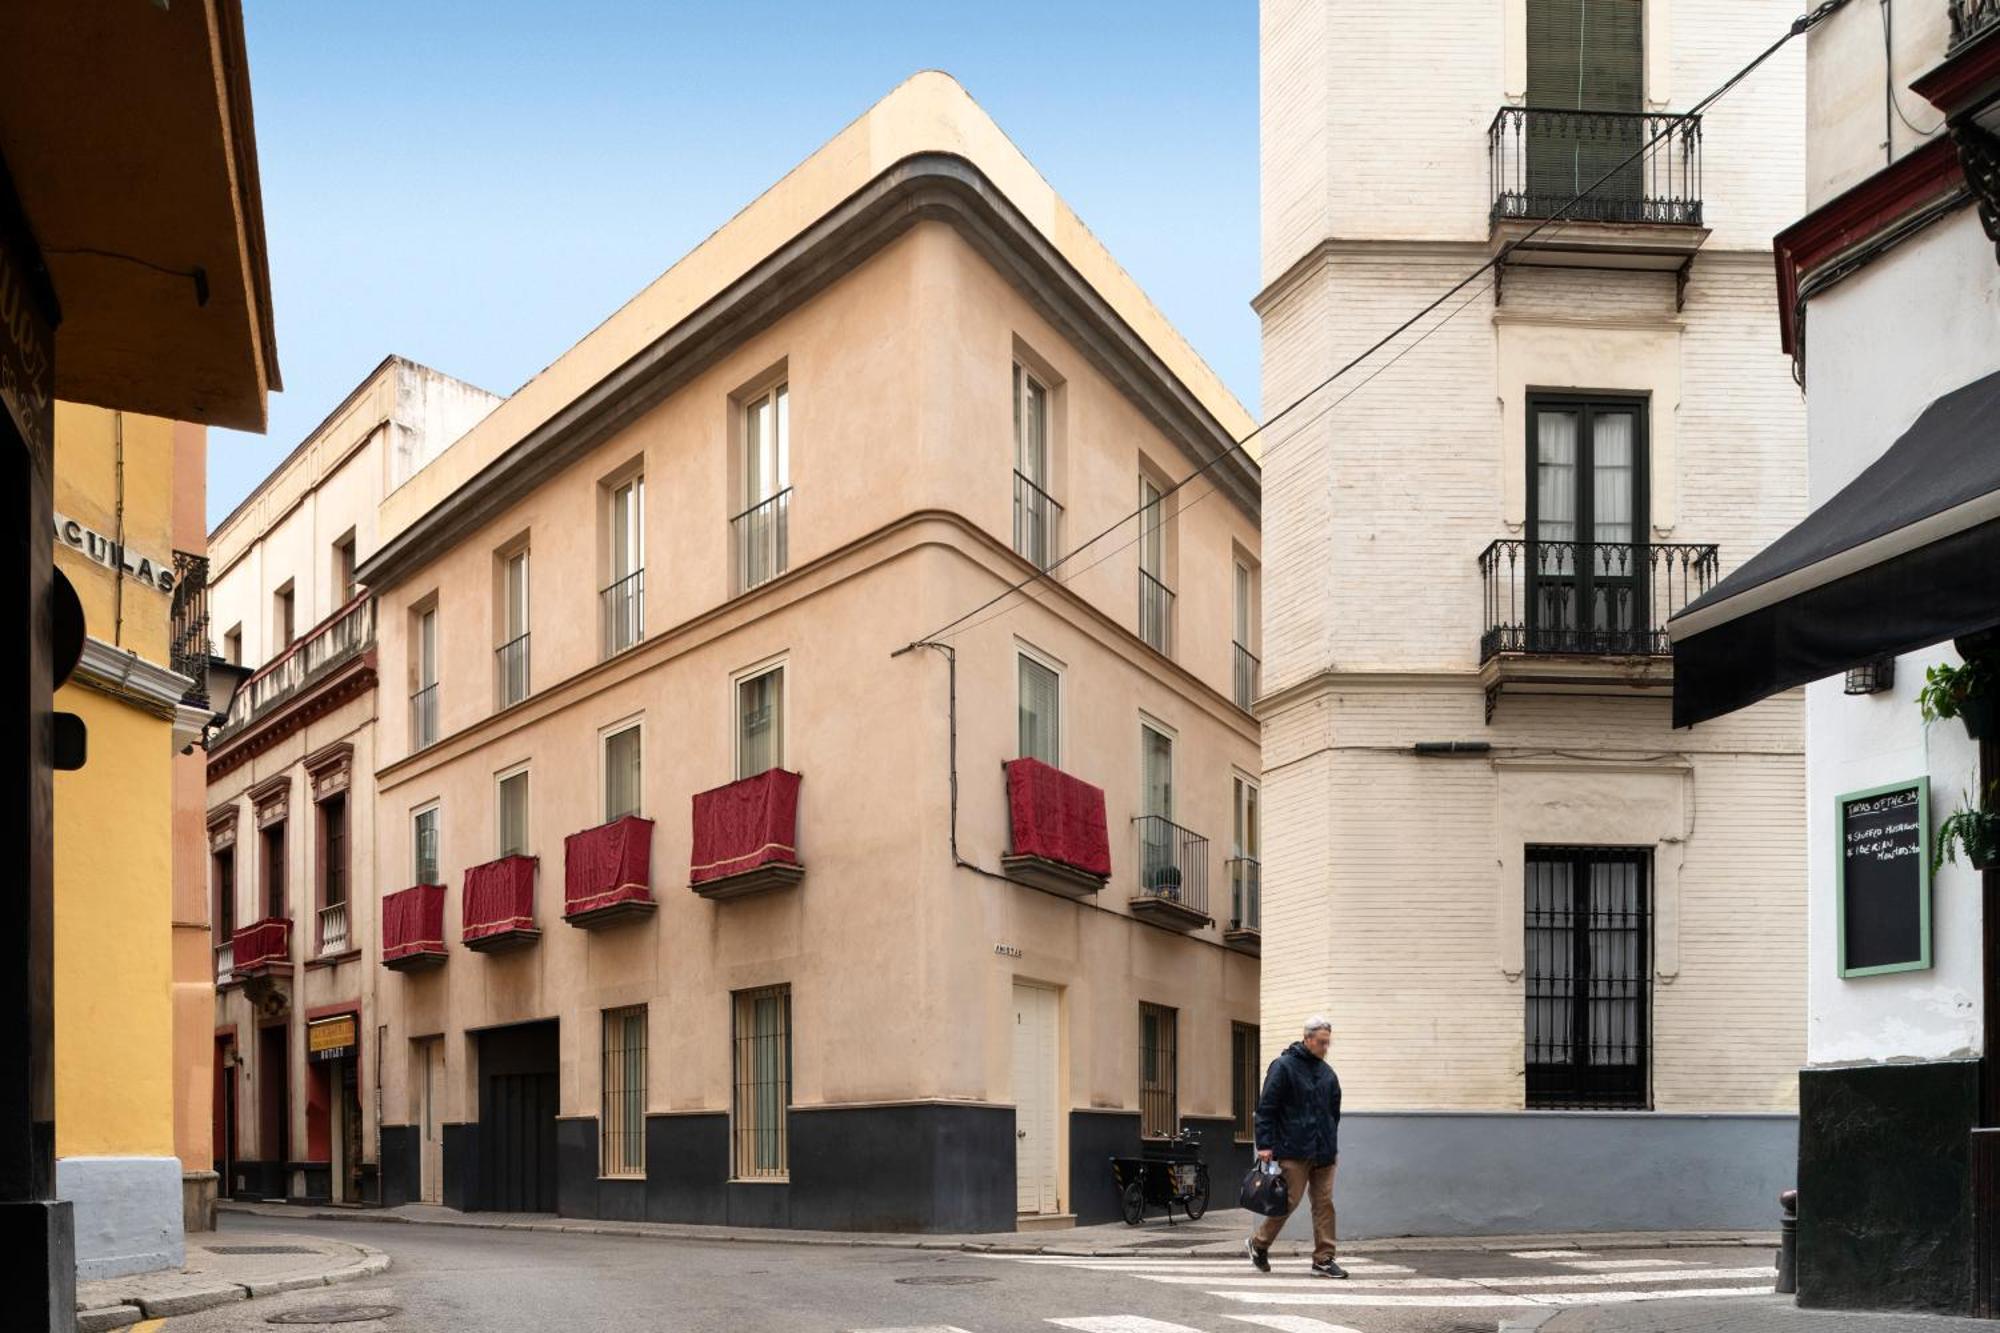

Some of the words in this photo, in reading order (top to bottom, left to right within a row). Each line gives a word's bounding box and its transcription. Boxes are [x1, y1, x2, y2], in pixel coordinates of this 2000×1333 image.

[53, 519, 176, 592] GUILAS
[1873, 800, 1886, 809] OF
[1887, 795, 1905, 806] THE
